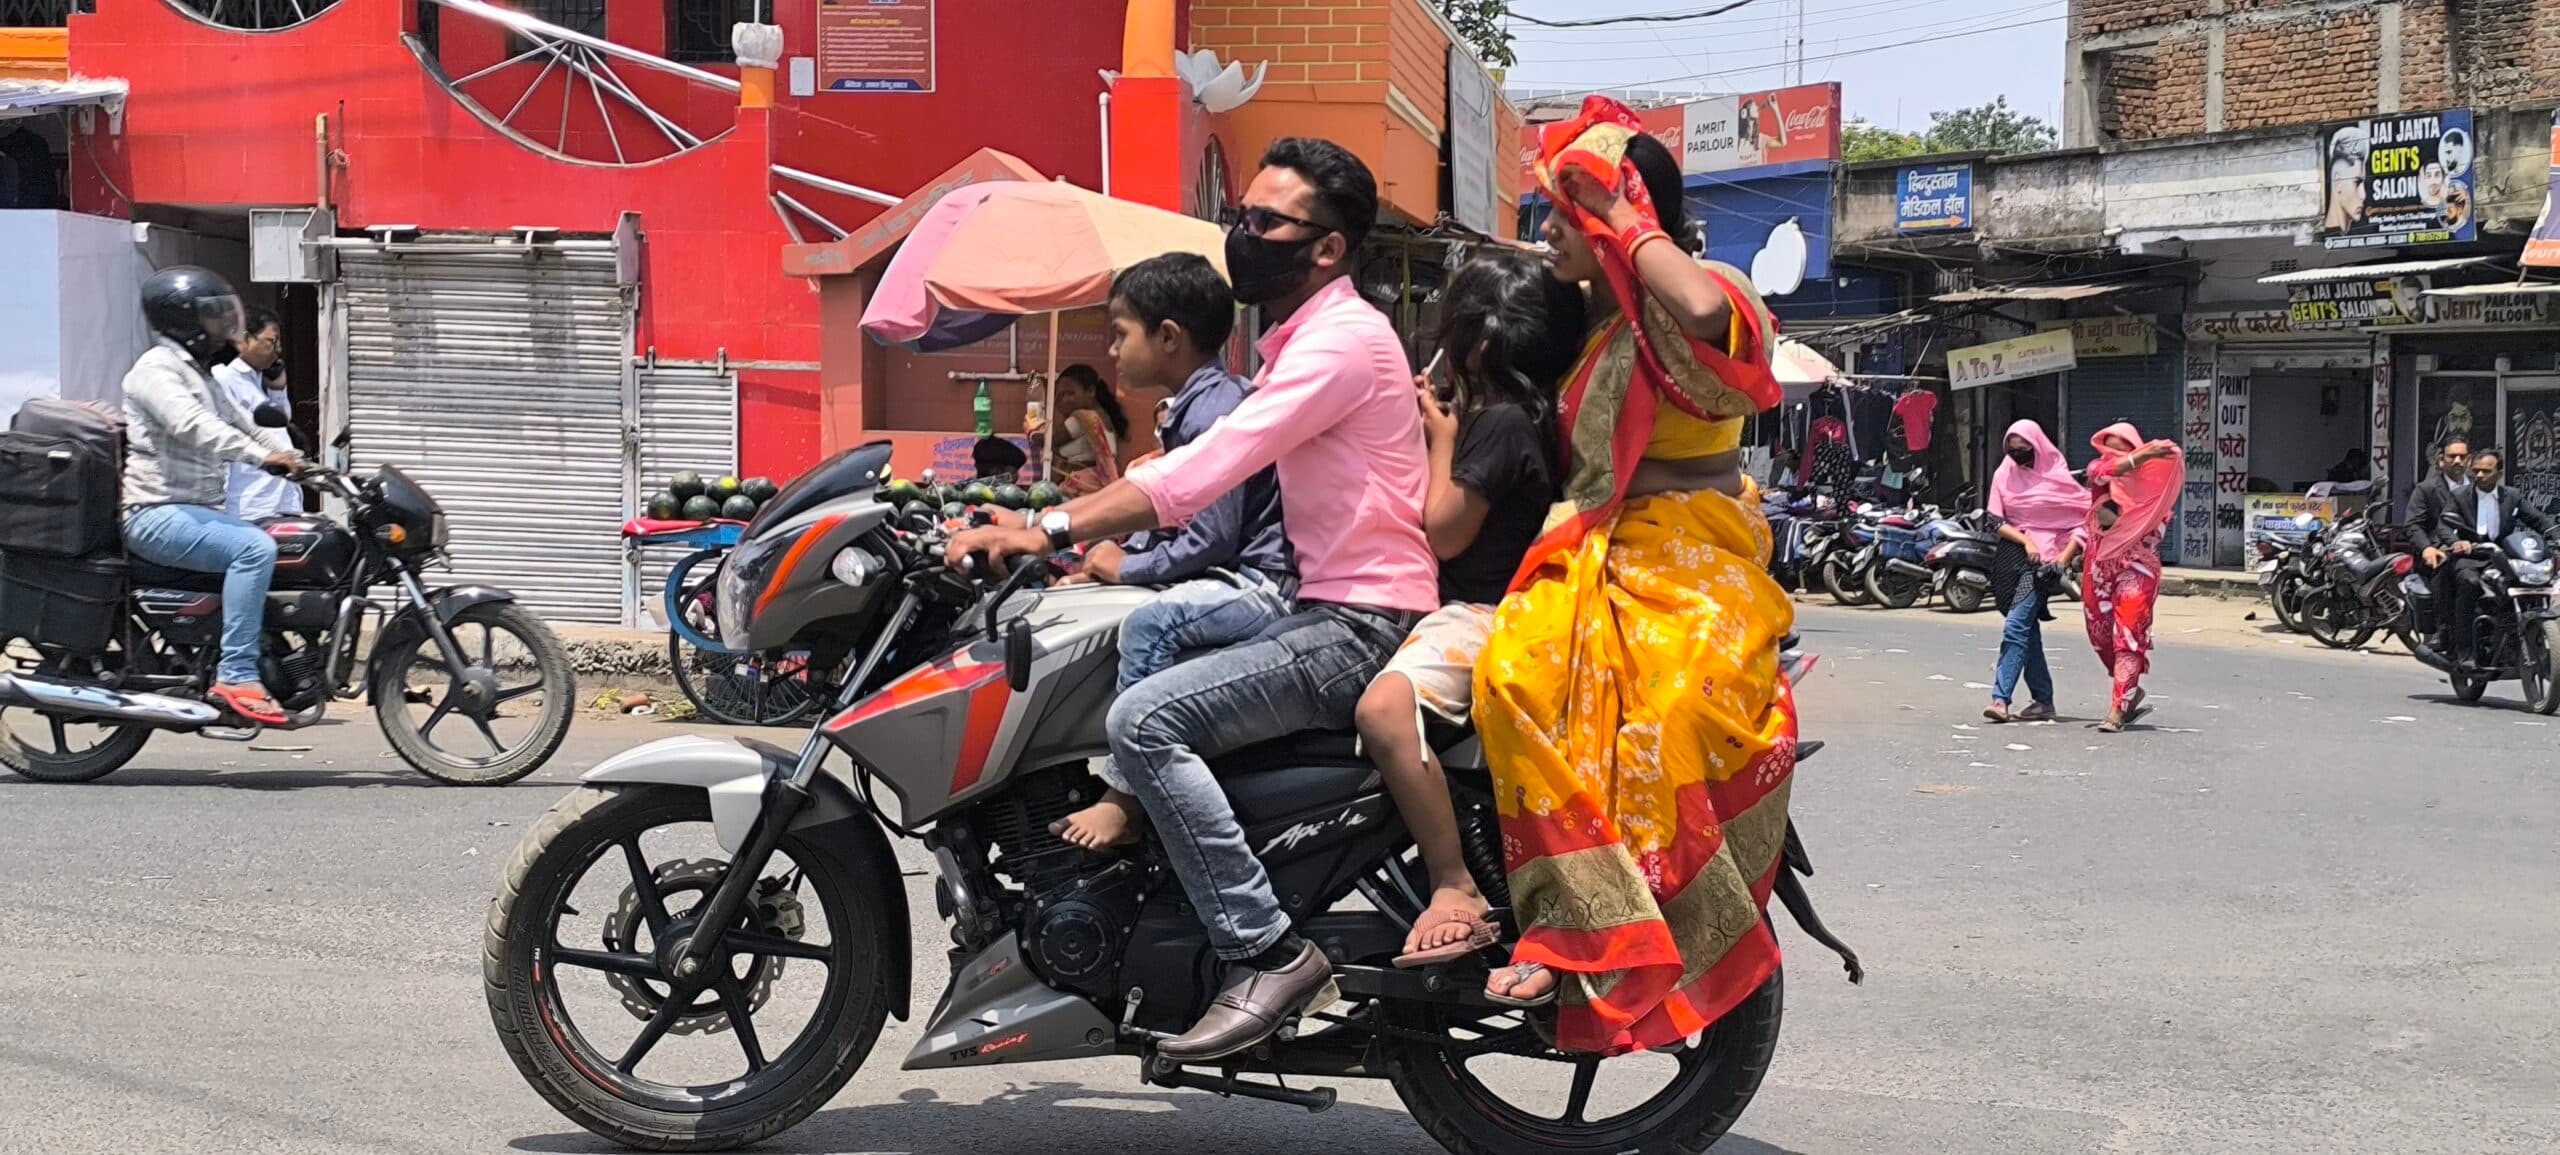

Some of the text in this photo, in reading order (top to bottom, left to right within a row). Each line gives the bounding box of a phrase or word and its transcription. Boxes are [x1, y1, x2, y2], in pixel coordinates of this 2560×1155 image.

[1695, 120, 1727, 136] AMRIT
[2370, 116, 2441, 145] JAI JANTA
[1687, 137, 1734, 154] PARLOUR
[2371, 146, 2420, 174] GENT'S
[2372, 176, 2418, 201] SALON
[1900, 195, 1942, 217] मेडिकल
[2312, 283, 2332, 300] JAI
[2334, 281, 2373, 299] JANTA
[2484, 292, 2537, 307] PARLOUR
[2291, 298, 2378, 321] GENT'S SALON
[2441, 298, 2480, 320] JENTS
[2484, 308, 2531, 323] SALOON
[1955, 359, 1968, 383] A
[1993, 353, 2005, 375] Z
[2219, 375, 2249, 396] PRINT
[2221, 404, 2246, 425] OUT
[2218, 432, 2246, 458] फोटो
[2218, 465, 2246, 493] स्टेट
[949, 1046, 978, 1060] TVS
